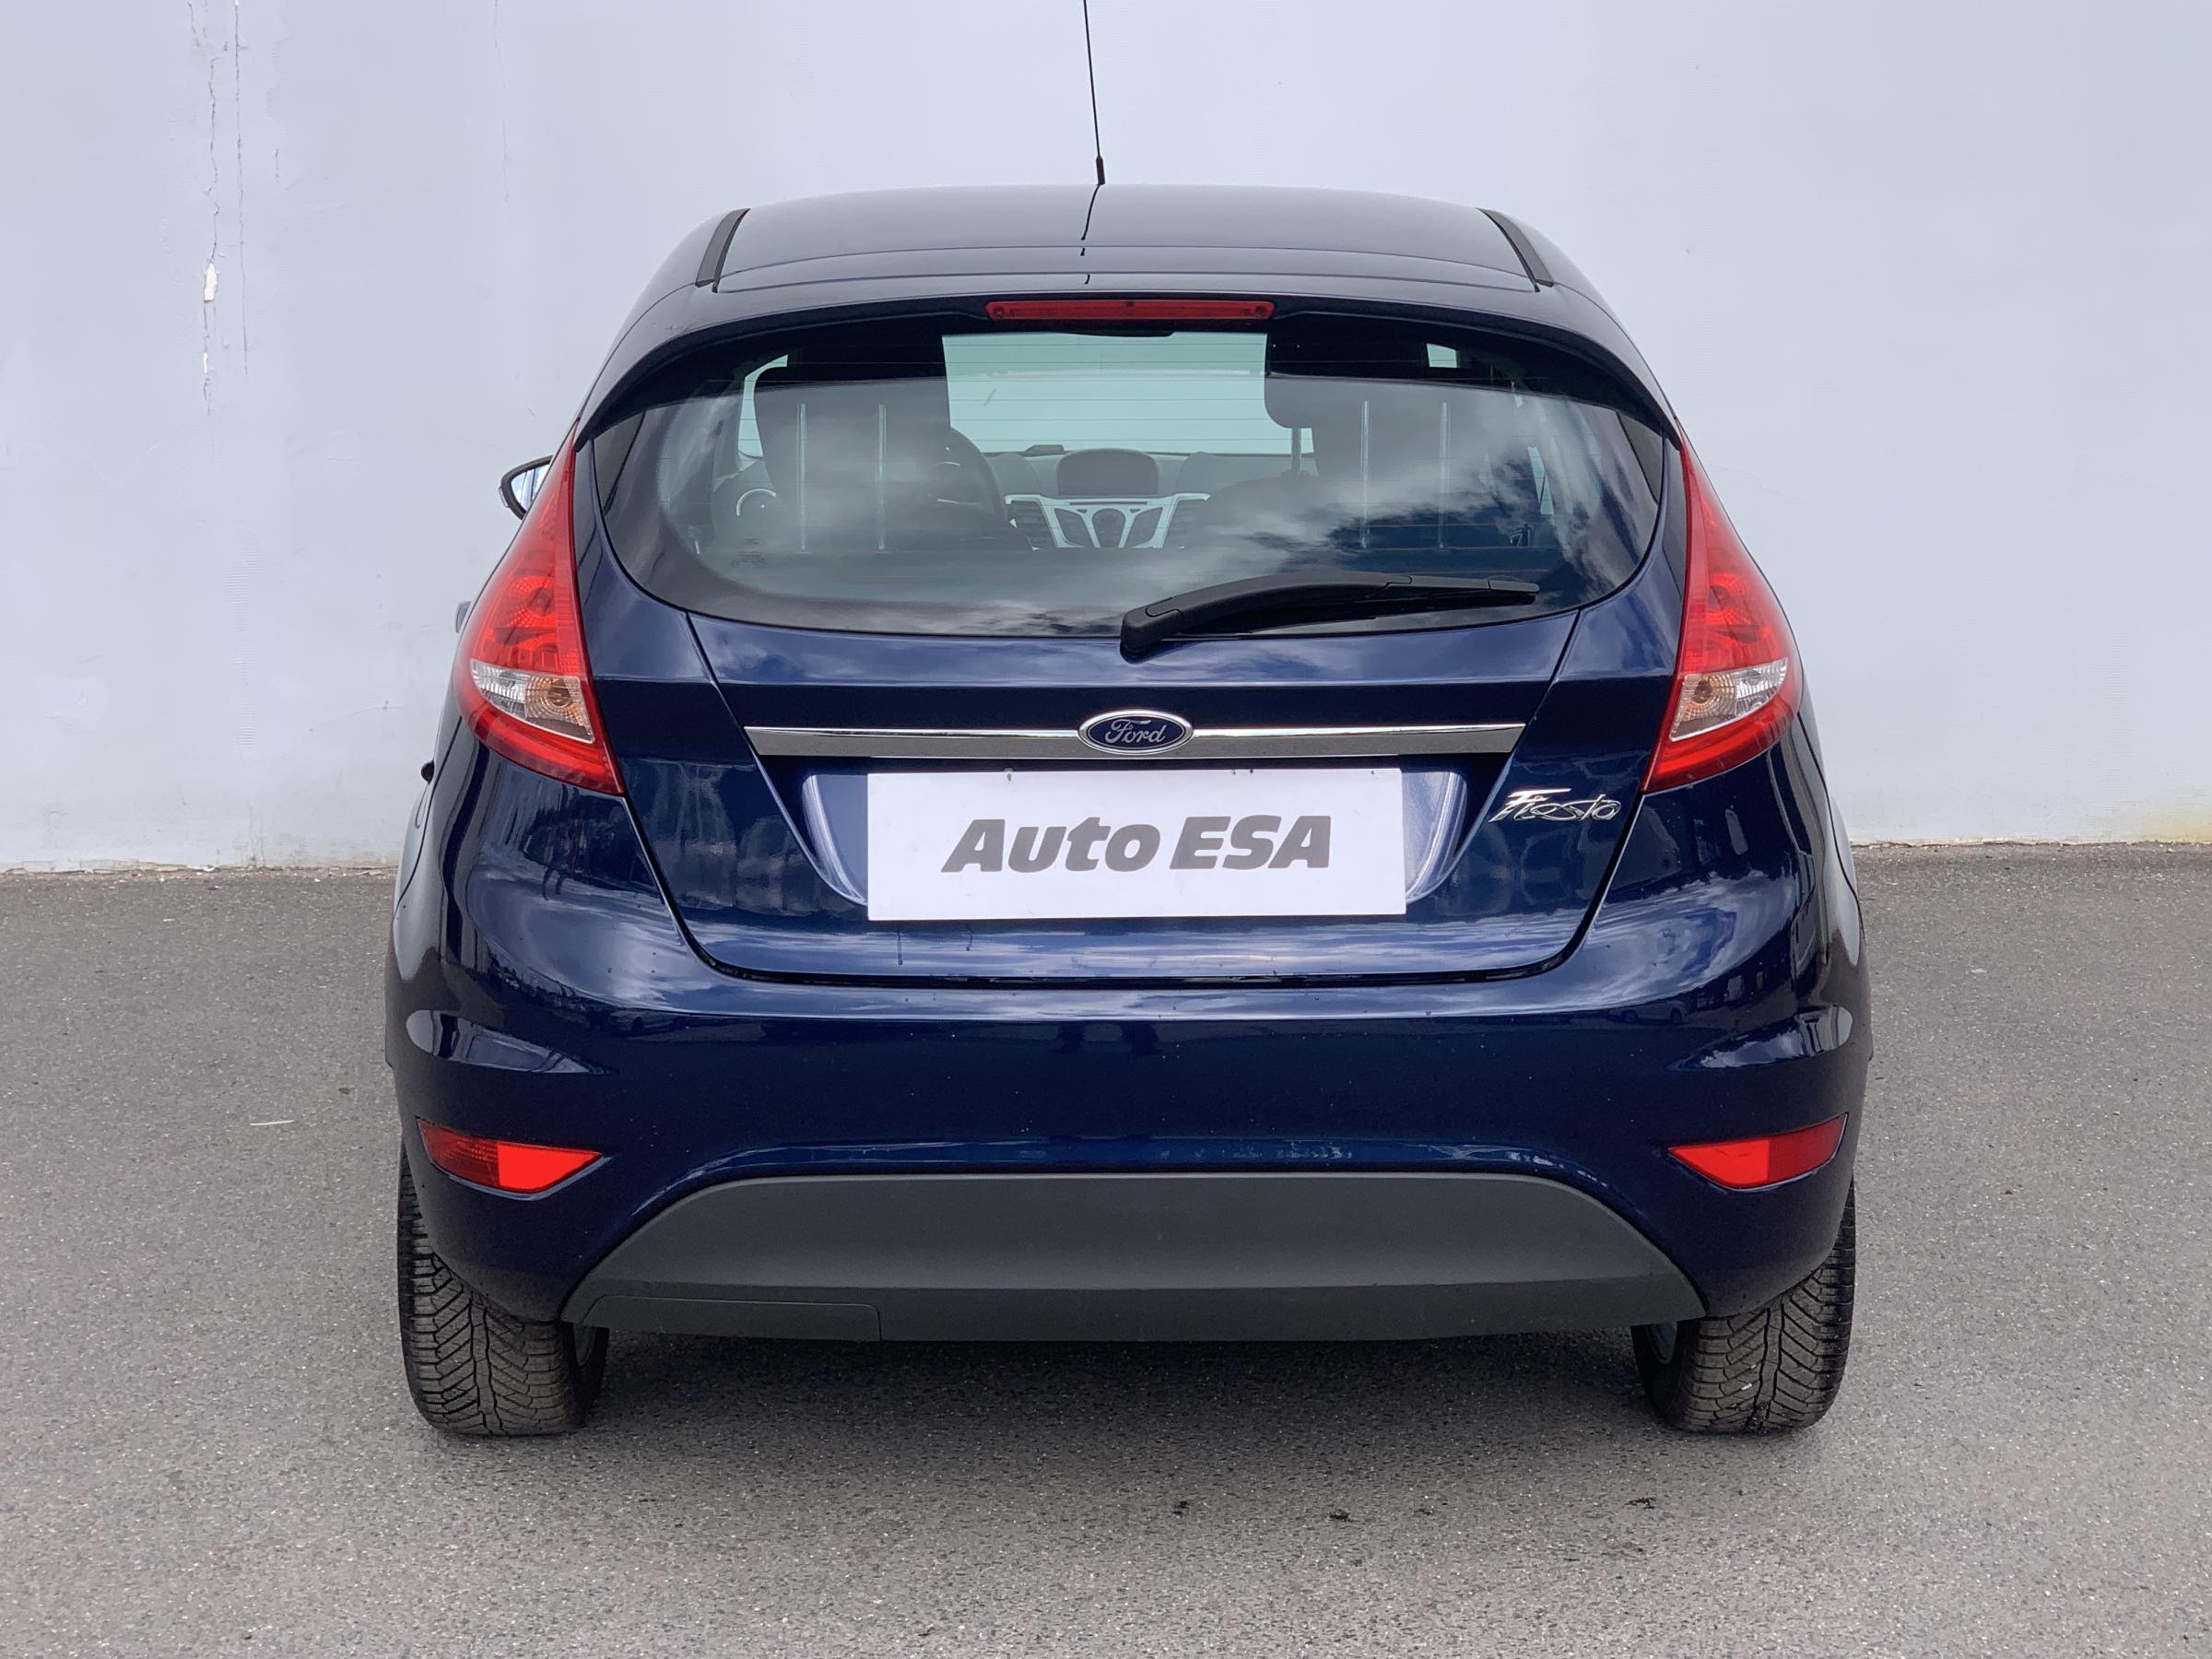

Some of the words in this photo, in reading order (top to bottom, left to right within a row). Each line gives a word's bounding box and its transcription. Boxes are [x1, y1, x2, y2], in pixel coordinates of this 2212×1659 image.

[1105, 719, 1167, 744] Ford
[1488, 788, 1622, 822] Fiesta
[940, 817, 1161, 873] Auto
[1170, 814, 1332, 870] ESA
